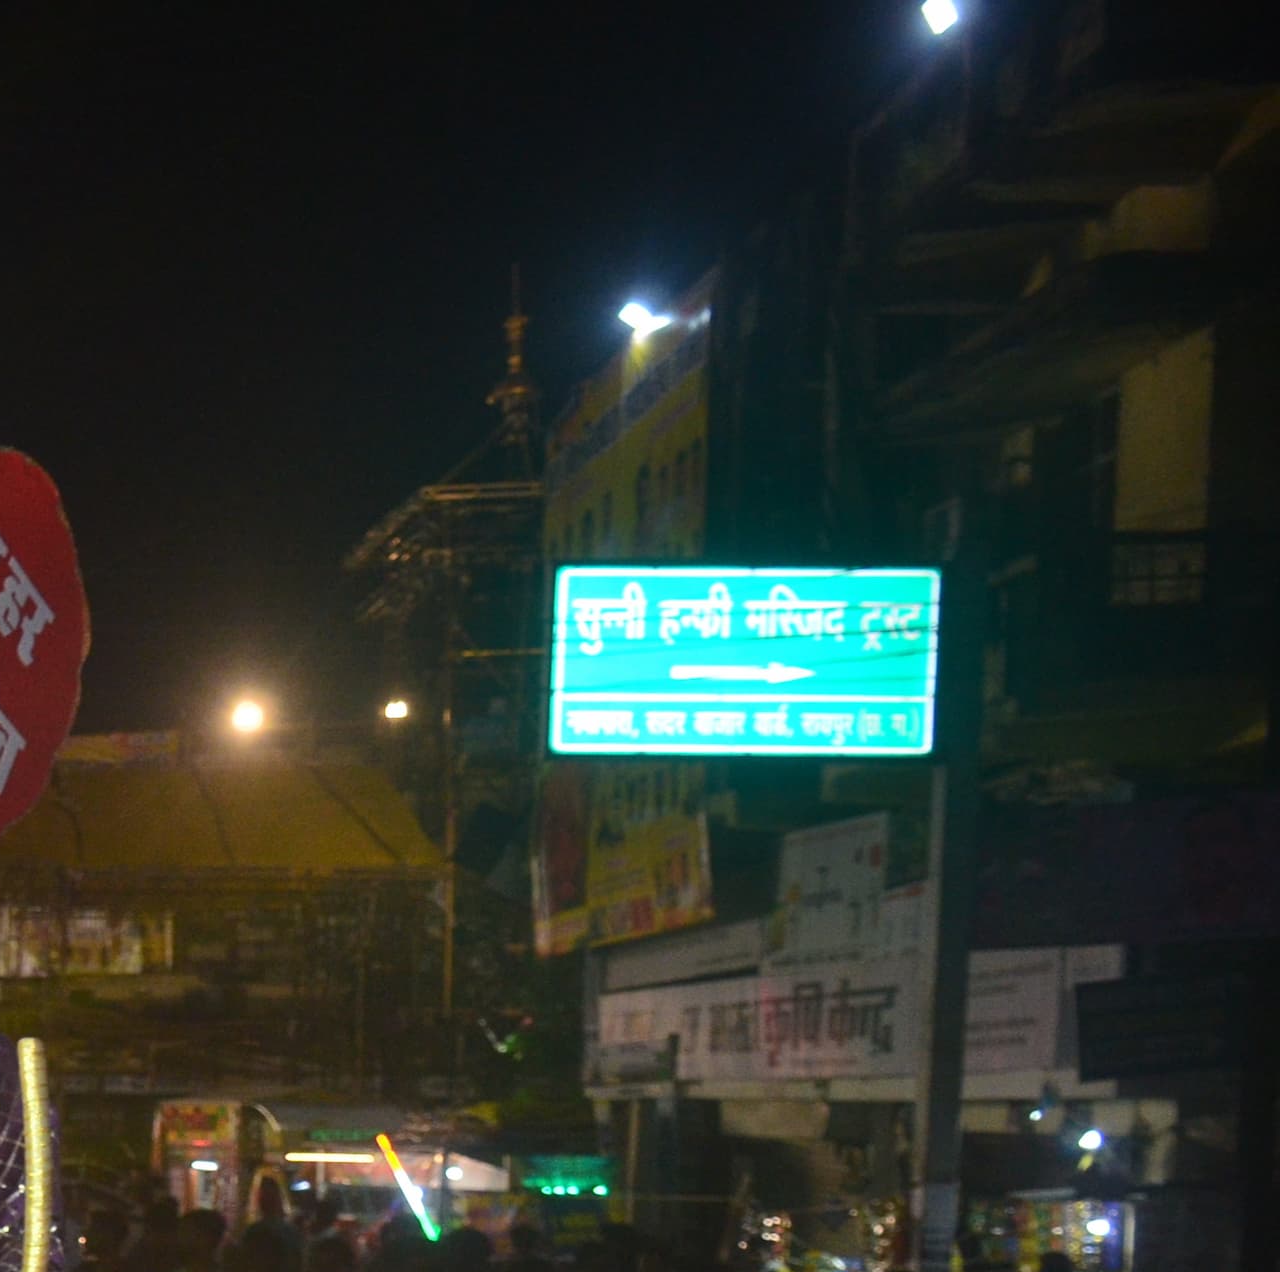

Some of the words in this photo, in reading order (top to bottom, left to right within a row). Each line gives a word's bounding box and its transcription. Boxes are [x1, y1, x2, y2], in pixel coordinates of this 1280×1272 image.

[571, 581, 648, 655] सुन्नी
[742, 584, 849, 642] मस्जिद
[858, 600, 924, 651] ट्रस्ट
